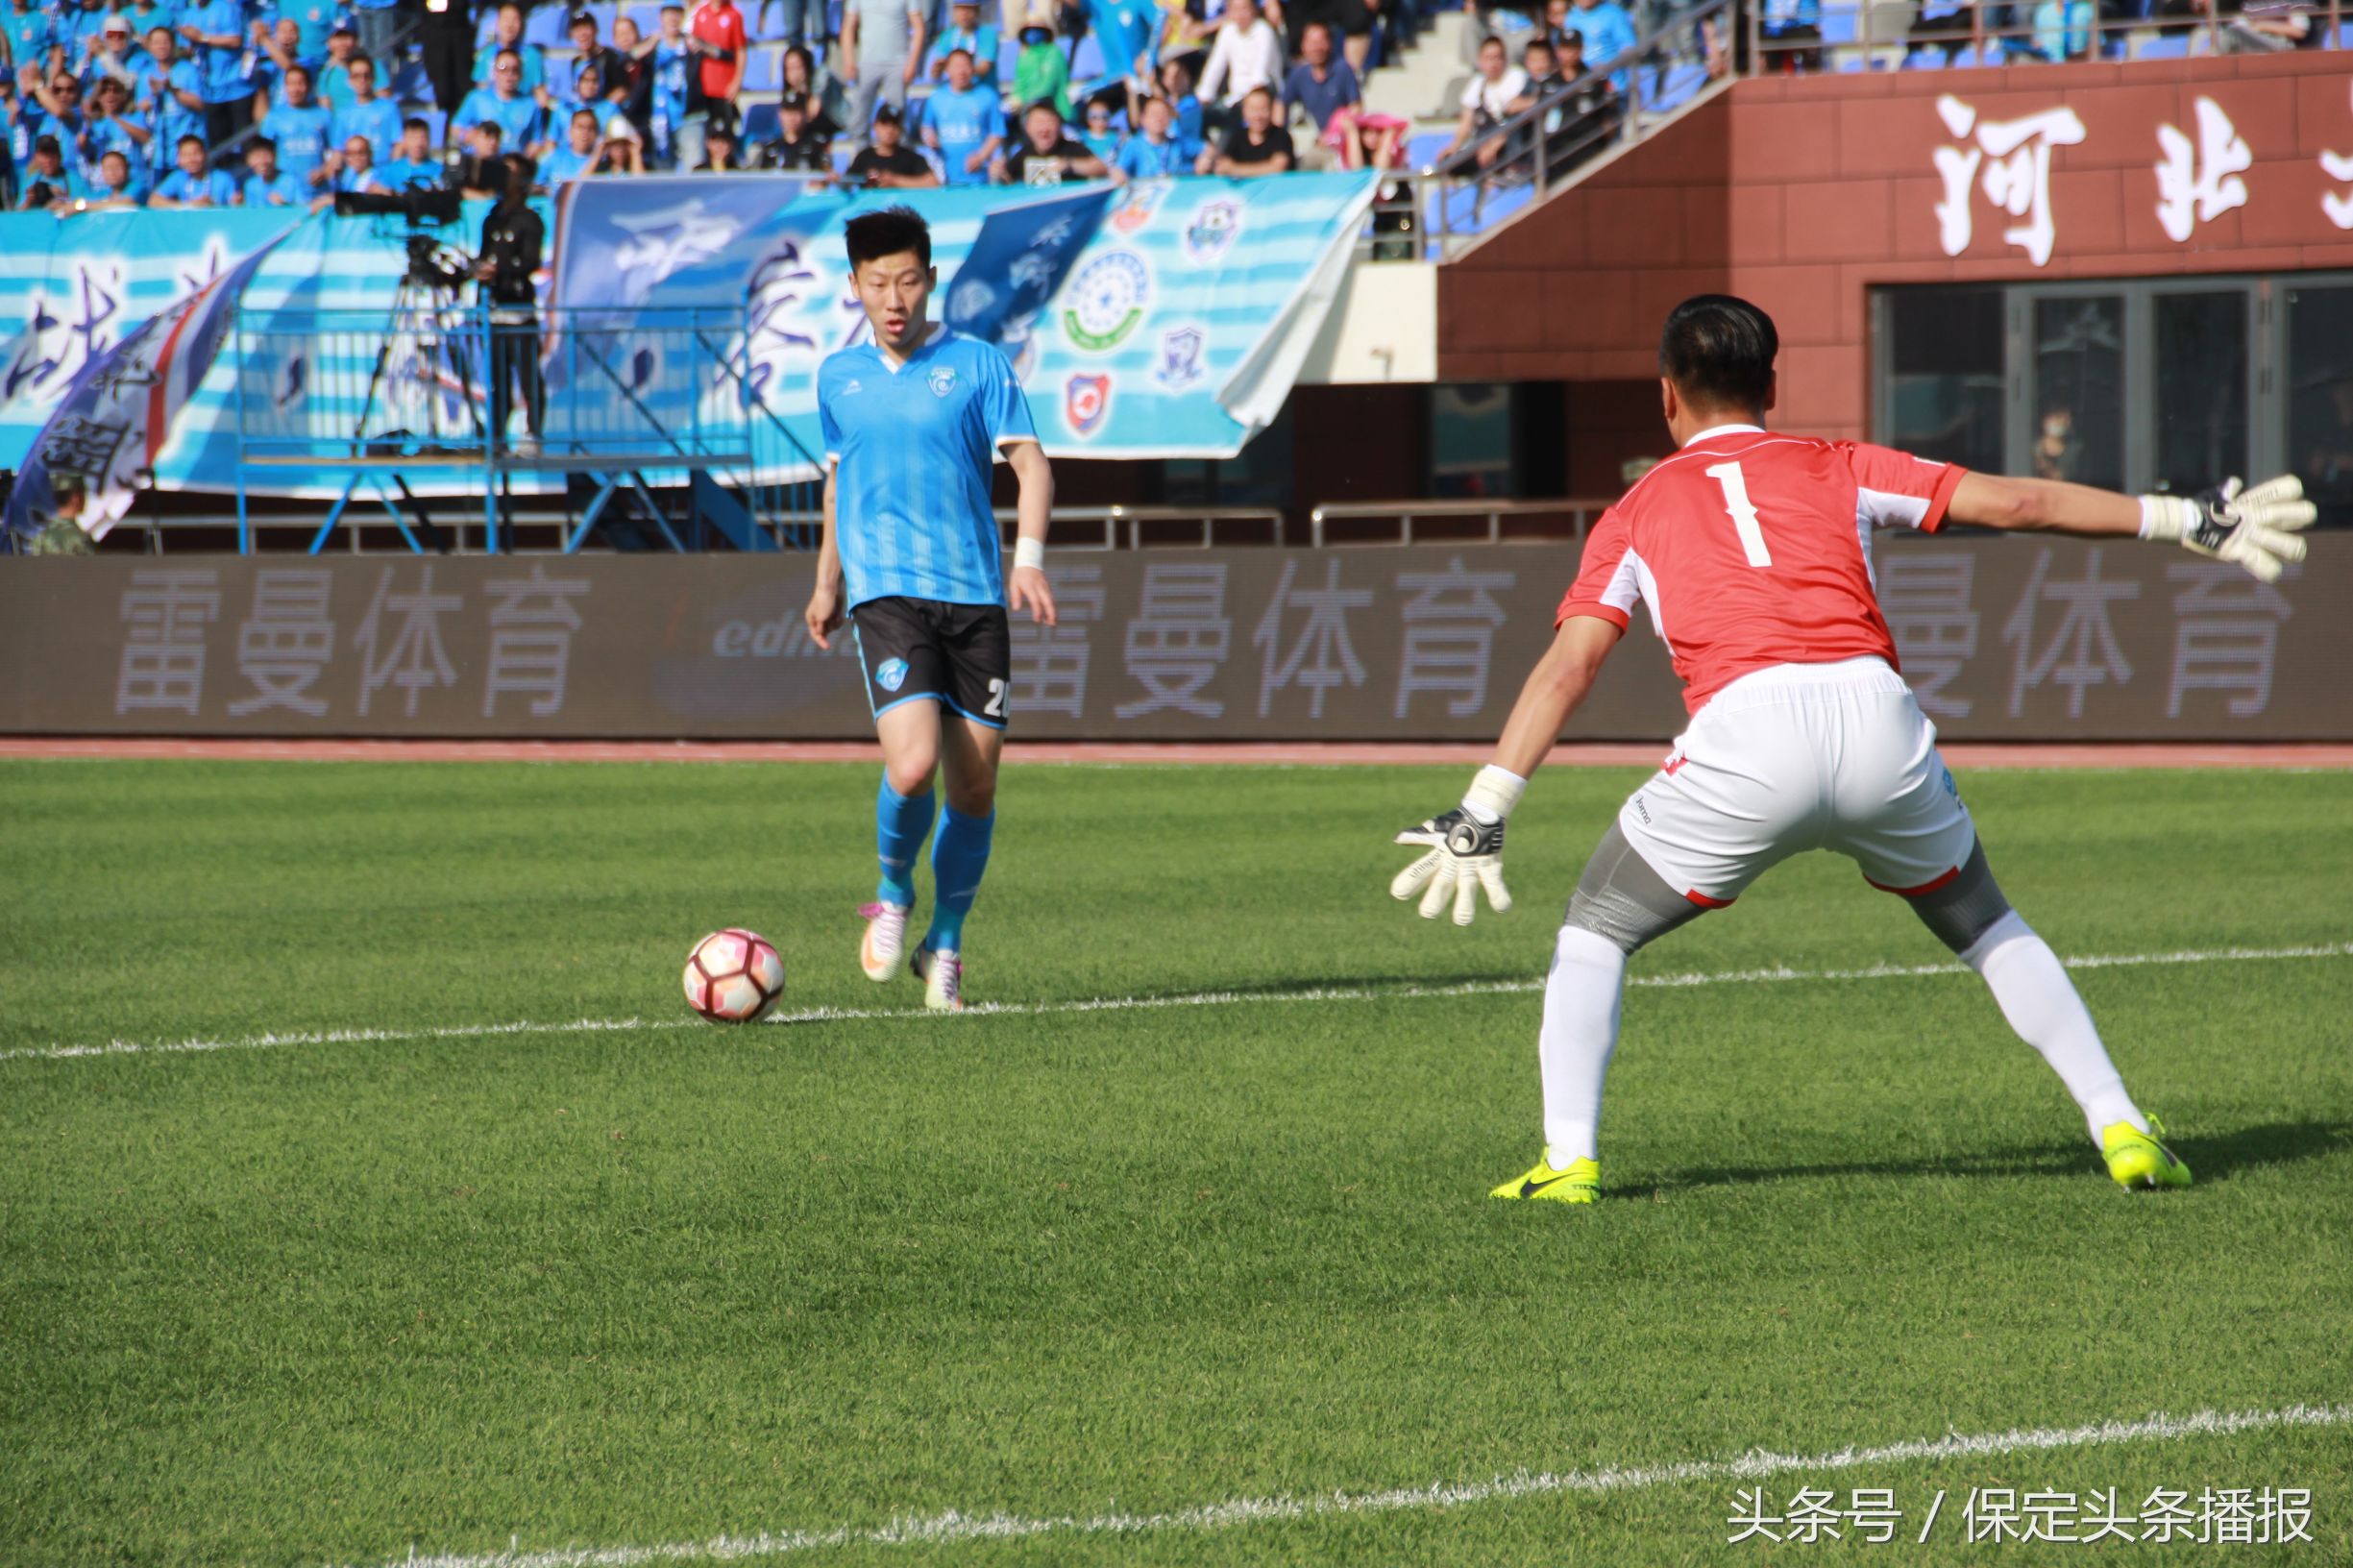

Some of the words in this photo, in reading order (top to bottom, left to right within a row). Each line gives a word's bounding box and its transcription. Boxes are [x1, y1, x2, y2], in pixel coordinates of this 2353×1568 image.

[1932, 93, 2353, 267] 河北
[1705, 460, 1773, 568] 1
[113, 562, 592, 718] 雷曼体育
